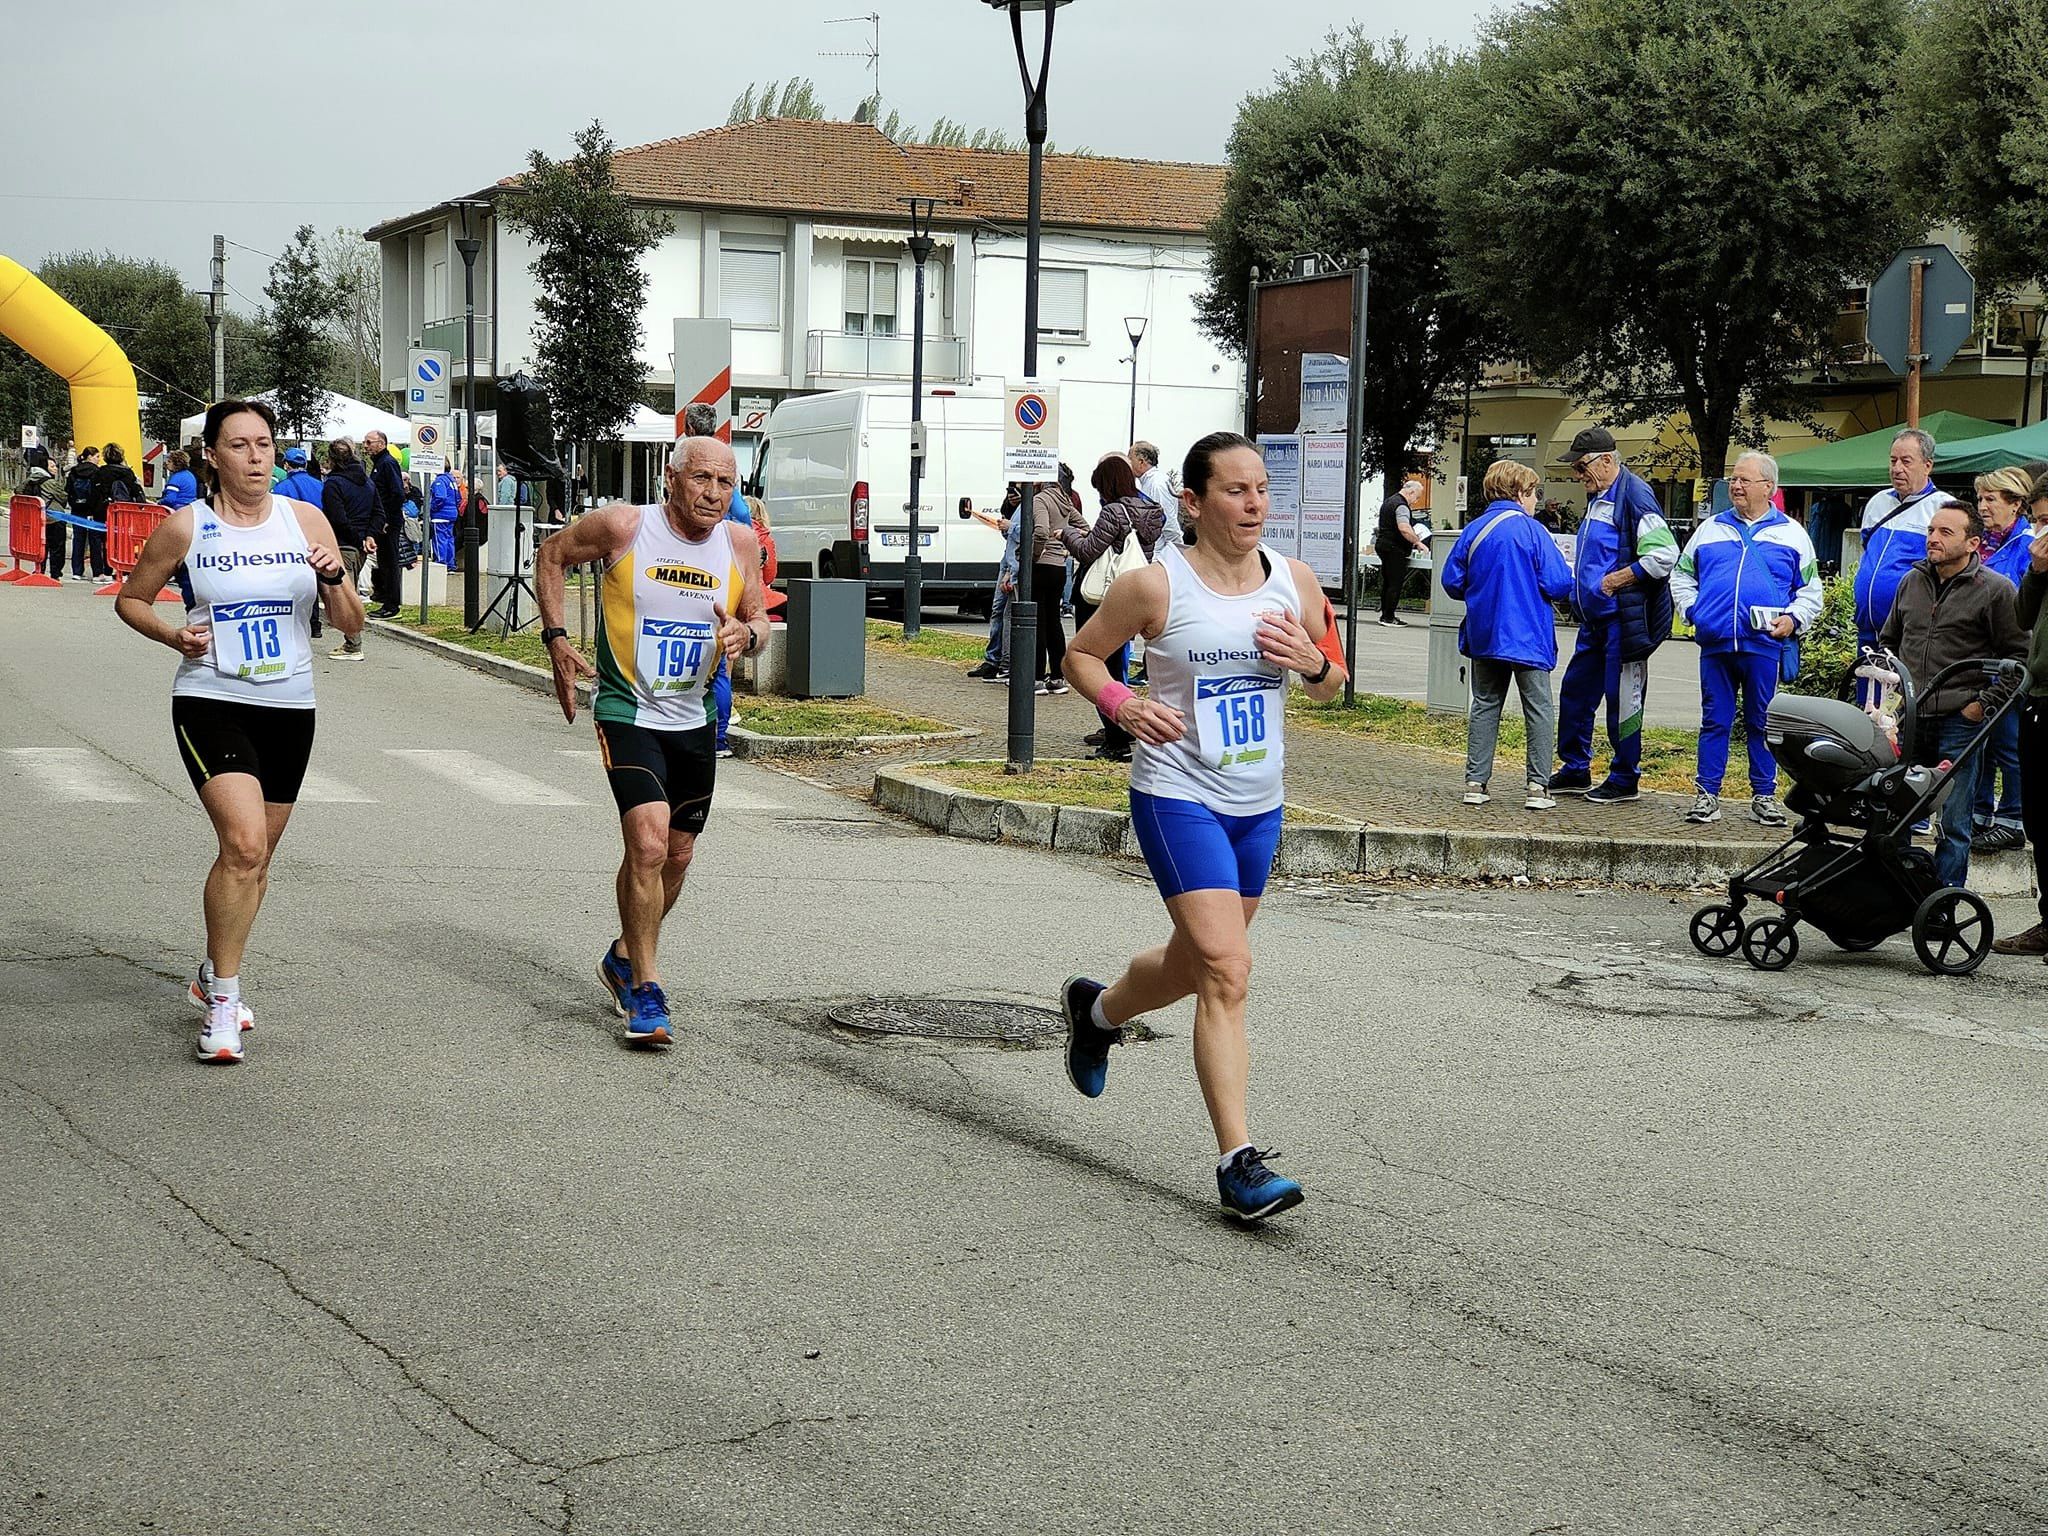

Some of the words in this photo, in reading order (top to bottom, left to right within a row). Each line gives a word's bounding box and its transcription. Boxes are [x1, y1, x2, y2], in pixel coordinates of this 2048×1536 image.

[413, 390, 422, 401] P
[1304, 383, 1321, 402] Ivan
[1322, 382, 1346, 402] Alvisi
[1265, 513, 1296, 521] GRAZIAMENTO
[1279, 527, 1296, 540] IVAN
[196, 551, 307, 572] lughesina
[655, 557, 685, 565] ATLETICA
[655, 567, 713, 588] MAMELI
[678, 590, 715, 602] RAVENNA
[238, 618, 281, 661] 113
[657, 639, 703, 677] 194
[1188, 649, 1266, 666] lughesin
[1215, 693, 1266, 747] 158
